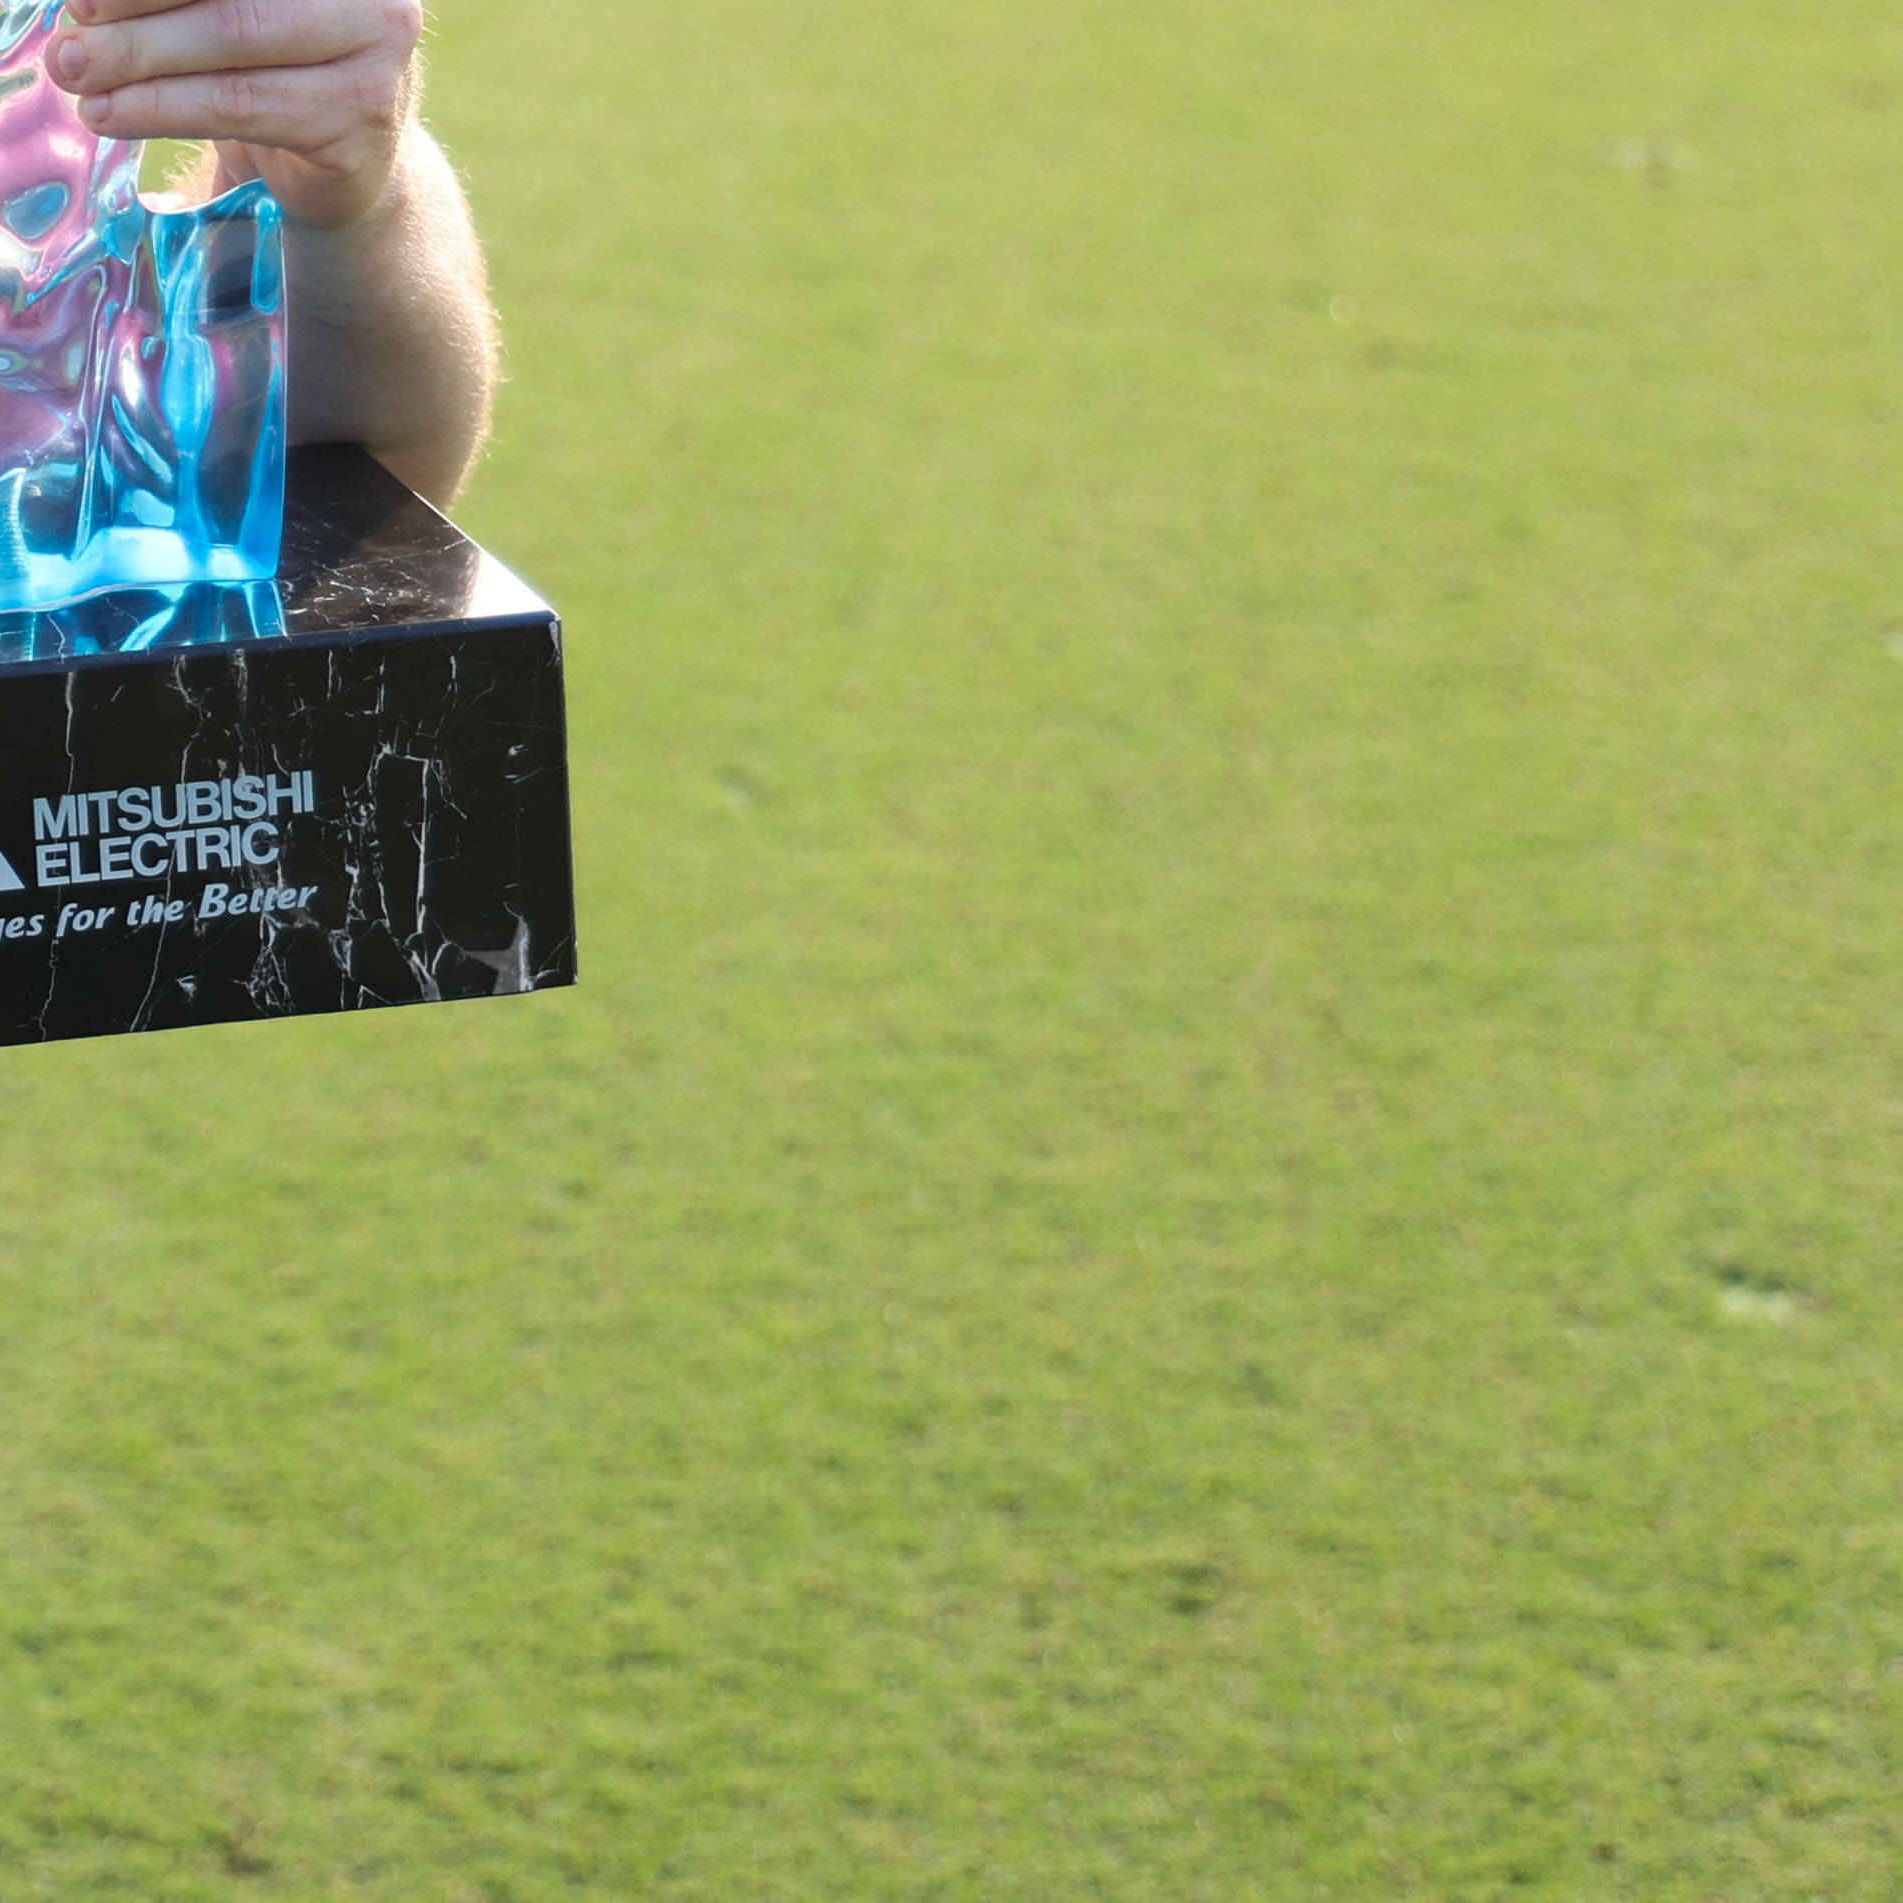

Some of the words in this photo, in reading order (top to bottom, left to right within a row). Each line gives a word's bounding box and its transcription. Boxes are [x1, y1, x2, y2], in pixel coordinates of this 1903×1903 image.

[33, 771, 315, 840] MITSUBISHI
[36, 821, 280, 888] ELECTRIC
[56, 901, 115, 938] for
[126, 894, 184, 927] the
[198, 882, 318, 920] Better
